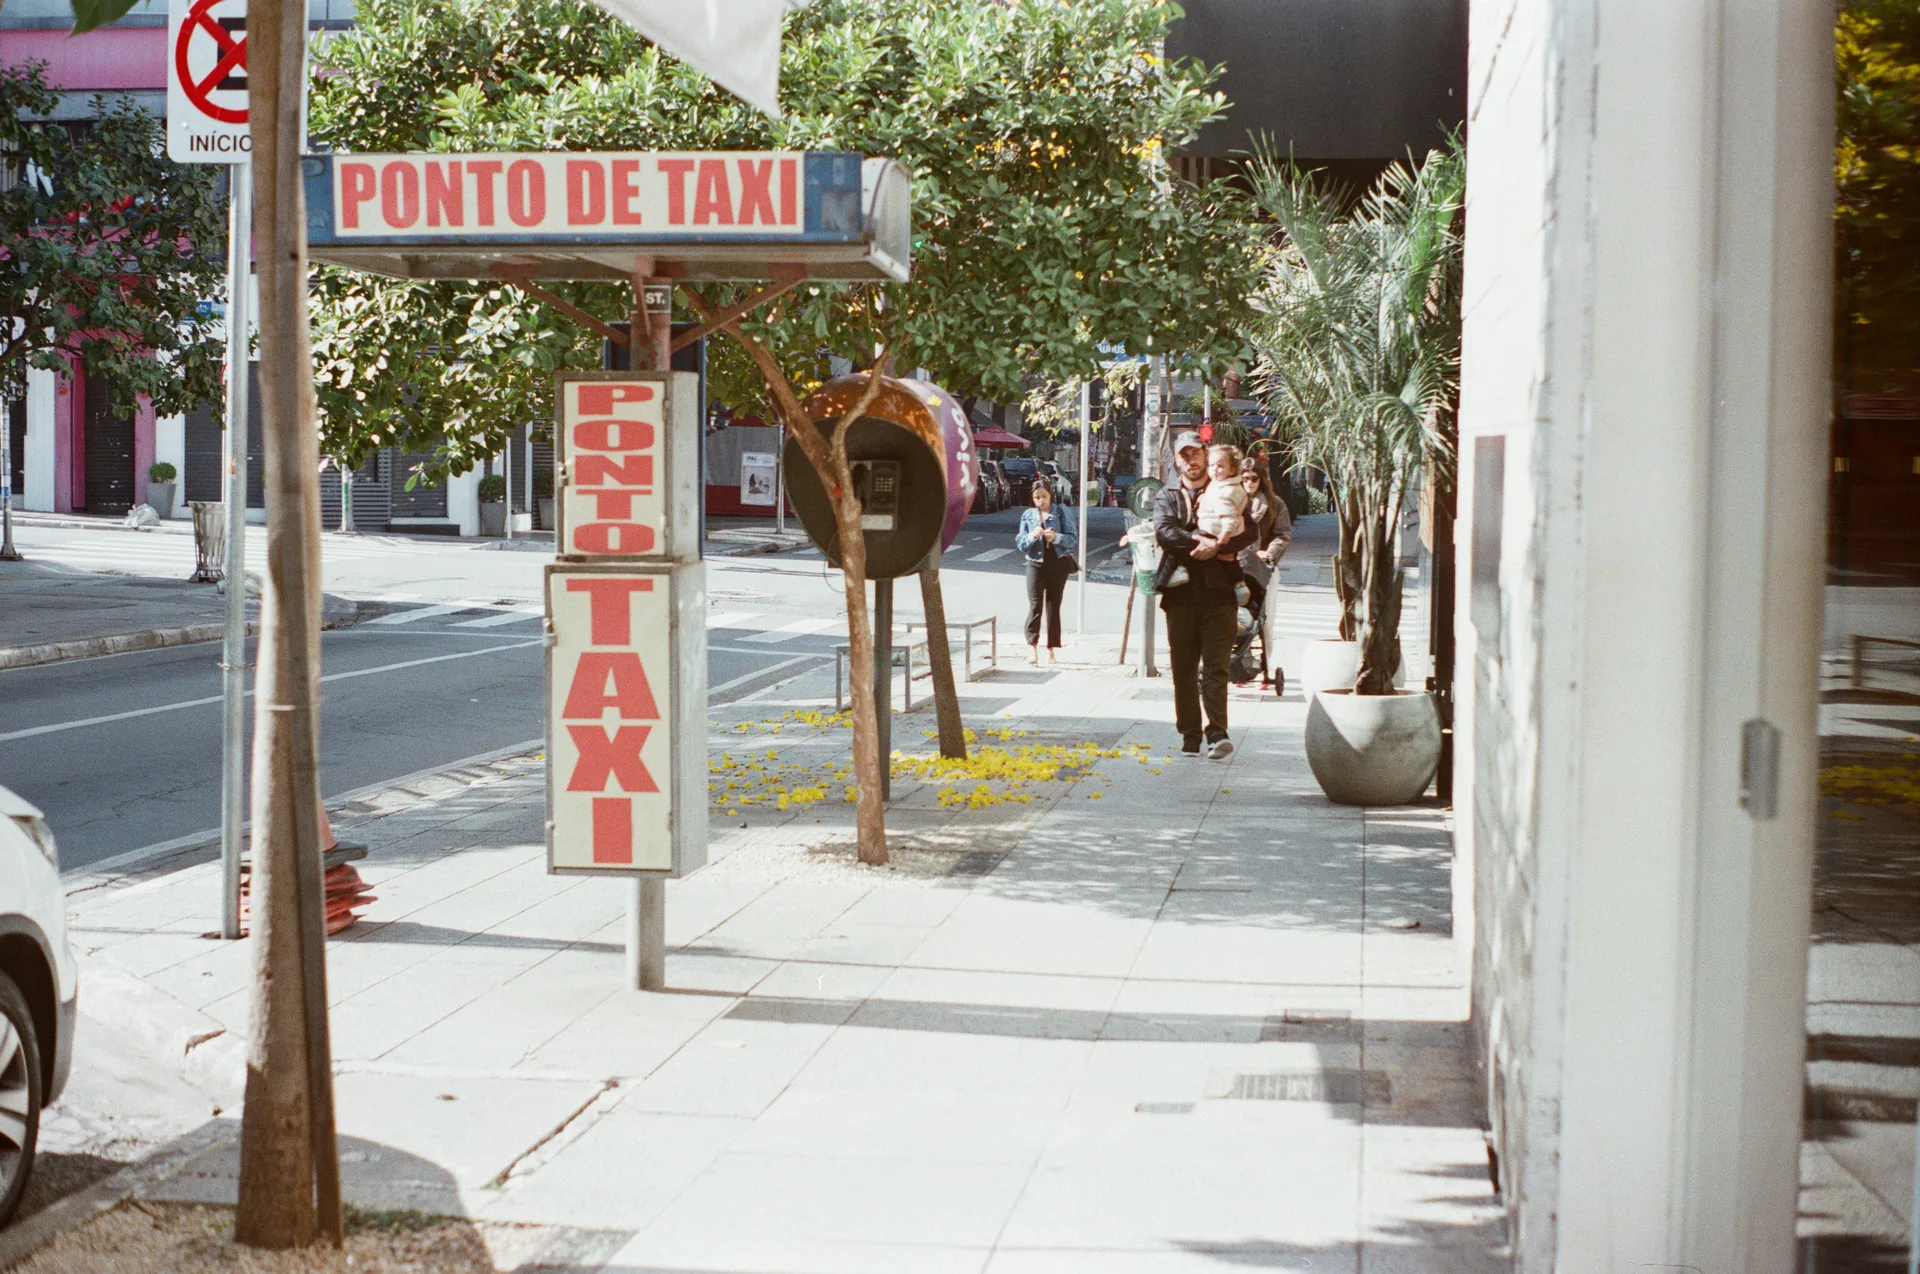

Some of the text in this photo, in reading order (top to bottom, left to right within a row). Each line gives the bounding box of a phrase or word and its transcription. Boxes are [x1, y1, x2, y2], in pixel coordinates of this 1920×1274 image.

[190, 131, 252, 152] INÍCIO
[341, 159, 797, 229] PONTO DE TAXI
[573, 384, 655, 555] PONTO
[951, 407, 971, 488] vivo
[562, 578, 661, 864] TAXI
